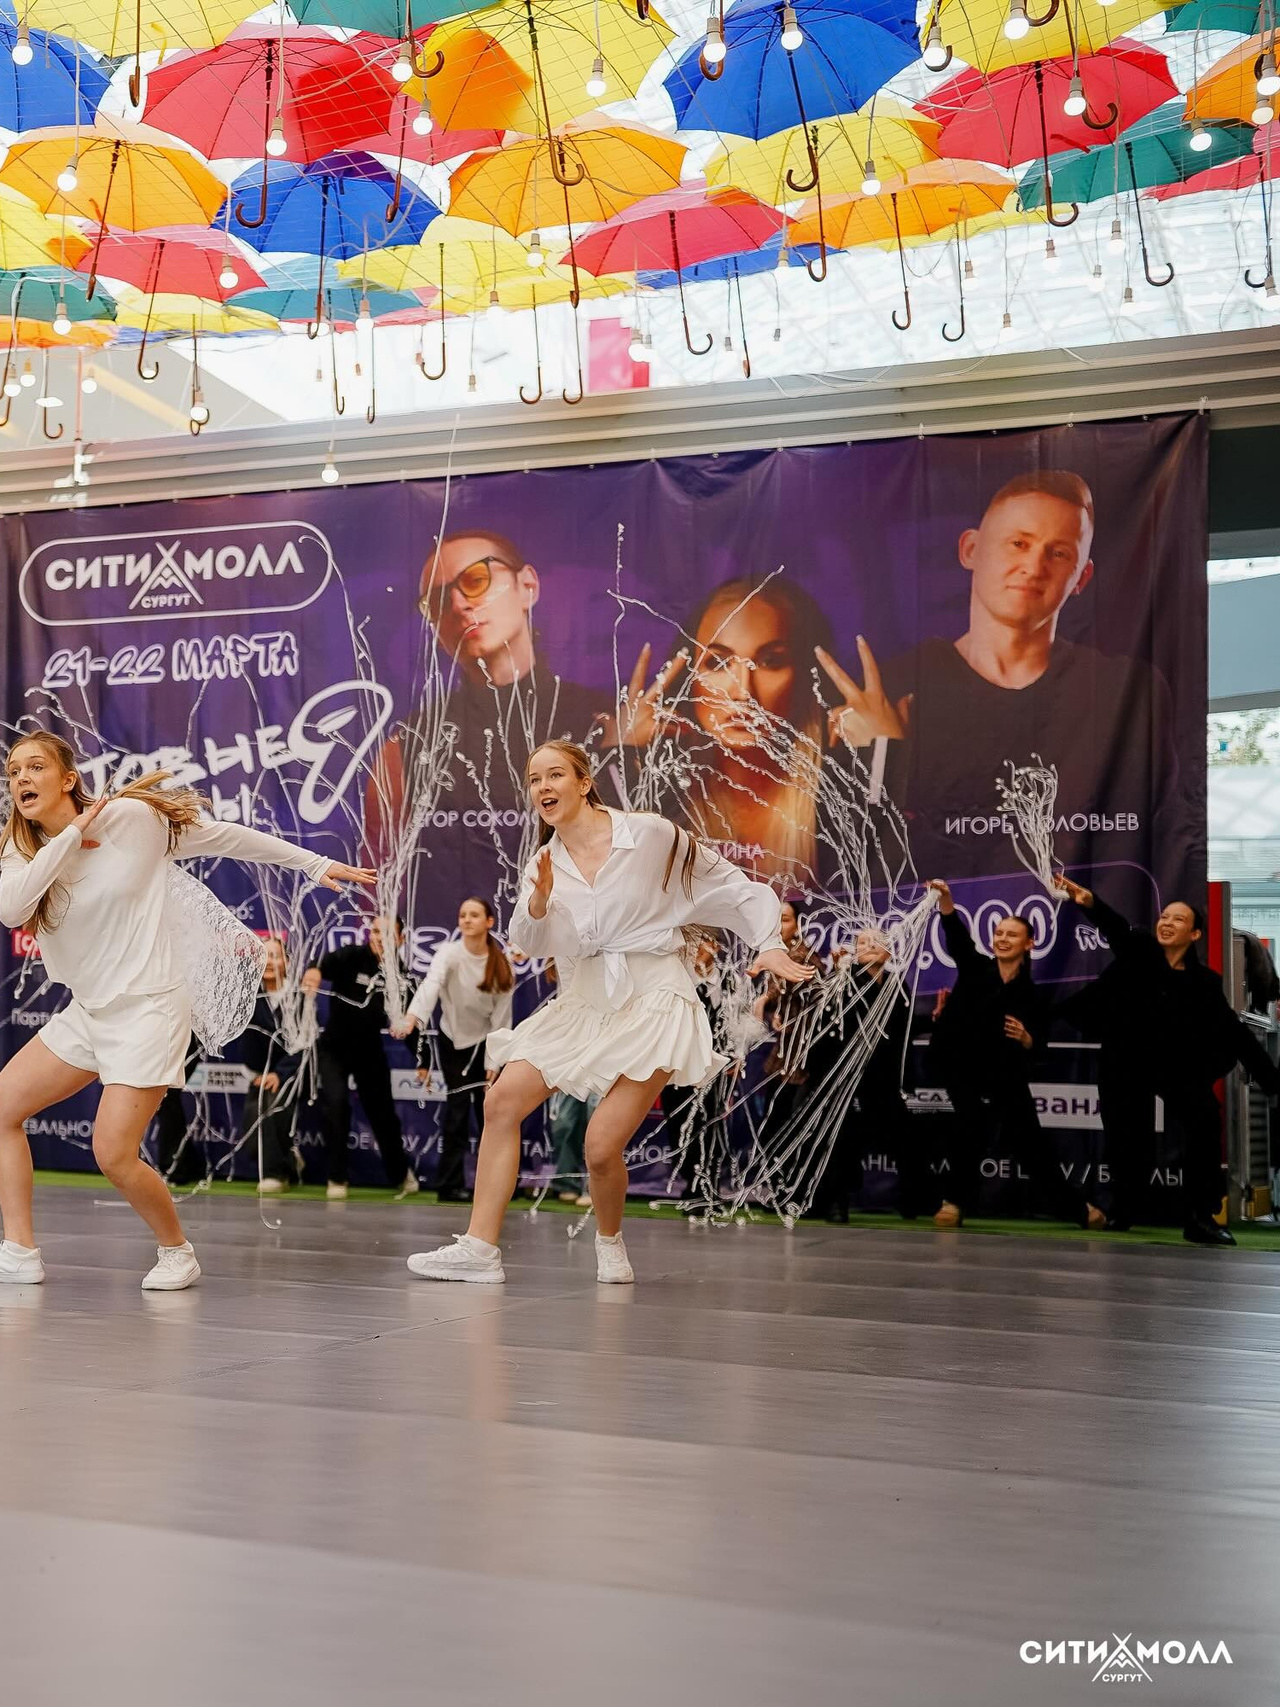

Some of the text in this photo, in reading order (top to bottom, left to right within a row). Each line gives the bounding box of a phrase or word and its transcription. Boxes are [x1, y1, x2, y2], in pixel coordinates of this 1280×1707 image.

[141, 592, 193, 609] СУРГУТ
[42, 631, 300, 688] 21-22 МАРТА
[945, 815, 1014, 835] ИГОРЬ
